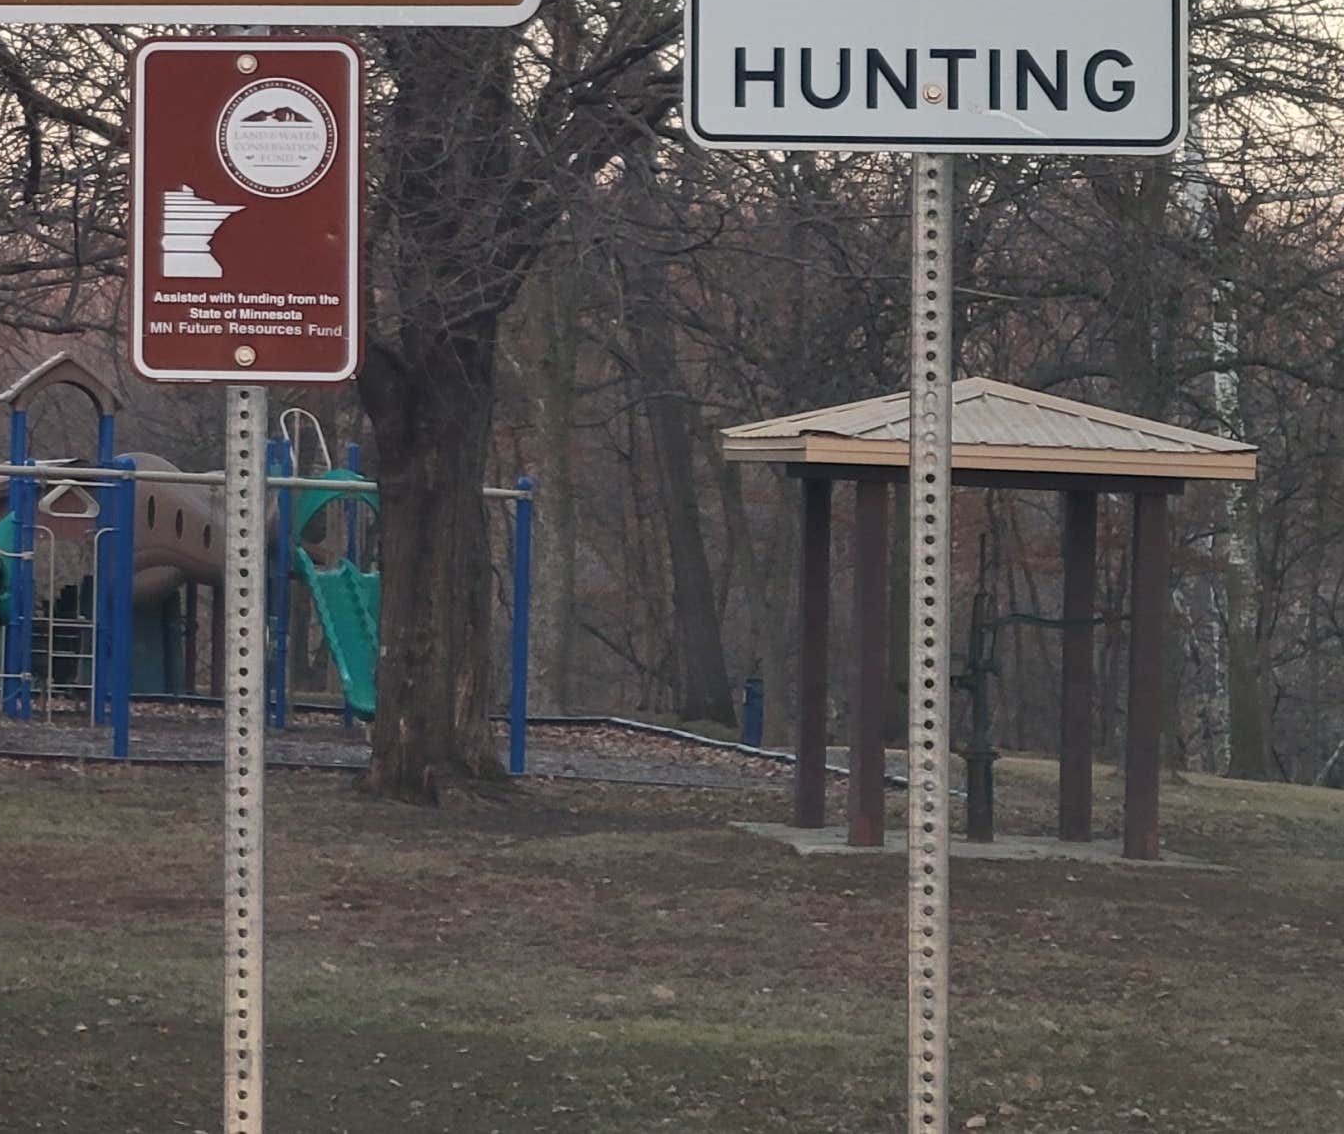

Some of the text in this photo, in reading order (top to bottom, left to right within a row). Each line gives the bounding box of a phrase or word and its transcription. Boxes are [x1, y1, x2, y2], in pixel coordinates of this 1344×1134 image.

[734, 47, 1135, 112] HUNTING
[154, 292, 339, 306] Assisted with funding from the
[190, 308, 302, 320] State of Minnesota
[150, 322, 342, 337] MN Future Resources Fund
